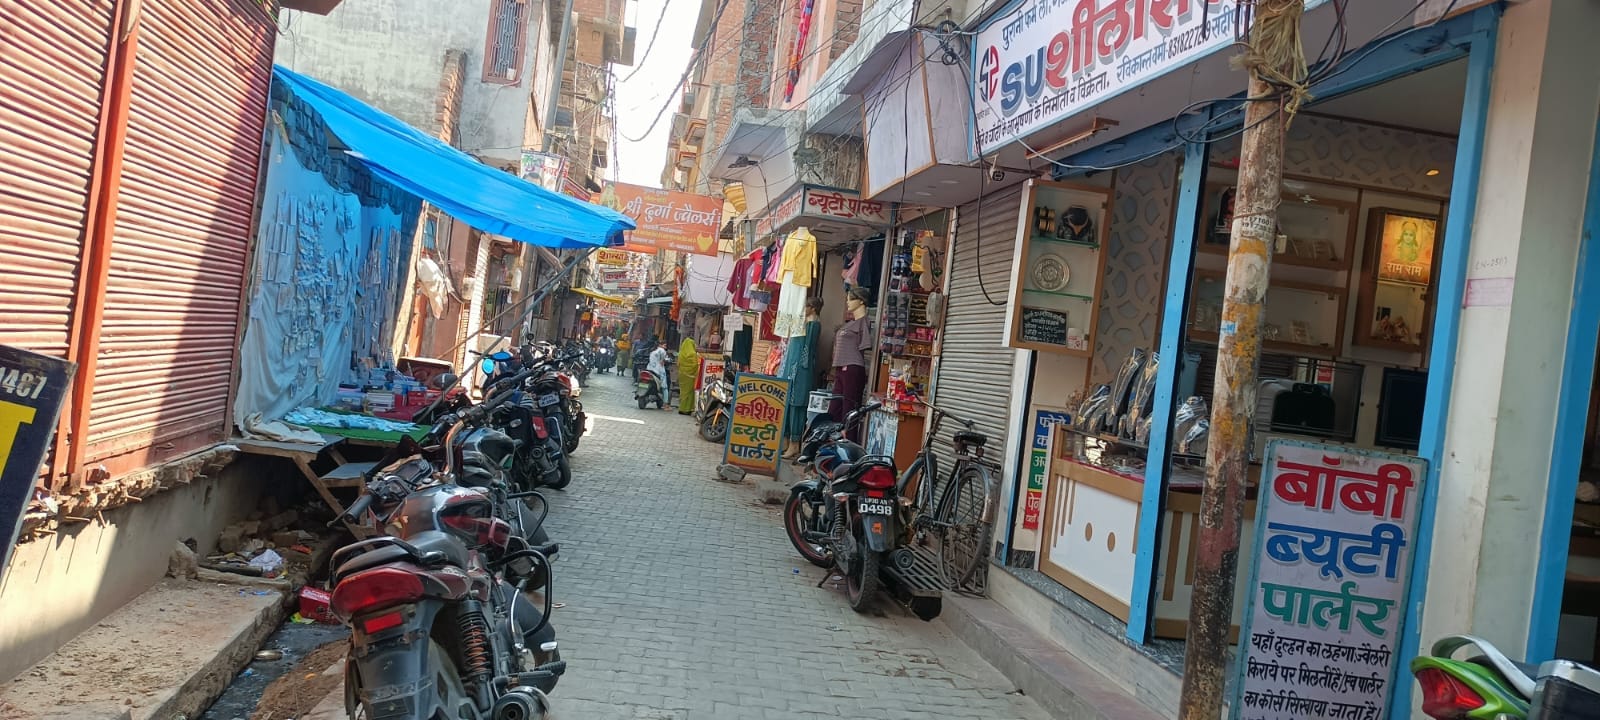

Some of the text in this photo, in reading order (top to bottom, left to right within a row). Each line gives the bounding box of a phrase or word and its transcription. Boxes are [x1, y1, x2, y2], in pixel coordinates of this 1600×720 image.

[626, 196, 642, 216] श्री
[644, 201, 675, 223] दुर्गा
[808, 192, 848, 214] ब्यूटी
[1386, 262, 1423, 277] राम राम
[735, 396, 782, 422] कशिश
[733, 423, 779, 442] ब्यूटी
[730, 442, 777, 461] पार्लर
[1274, 454, 1414, 519] बॉबी
[860, 503, 892, 516] 0498
[1266, 522, 1407, 579] ब्यूटी
[1260, 581, 1396, 637] पार्लर
[1252, 629, 1275, 654] यहाँ
[1274, 635, 1307, 658] दुल्हन
[1305, 641, 1321, 657] का
[1247, 656, 1280, 682] किराये
[1280, 665, 1297, 686] पर
[1358, 671, 1386, 698] पार्लर
[1243, 690, 1260, 708] का
[1258, 688, 1287, 713] कोर्स
[1284, 690, 1329, 718] सिखाया
[1328, 702, 1367, 720] जाता
